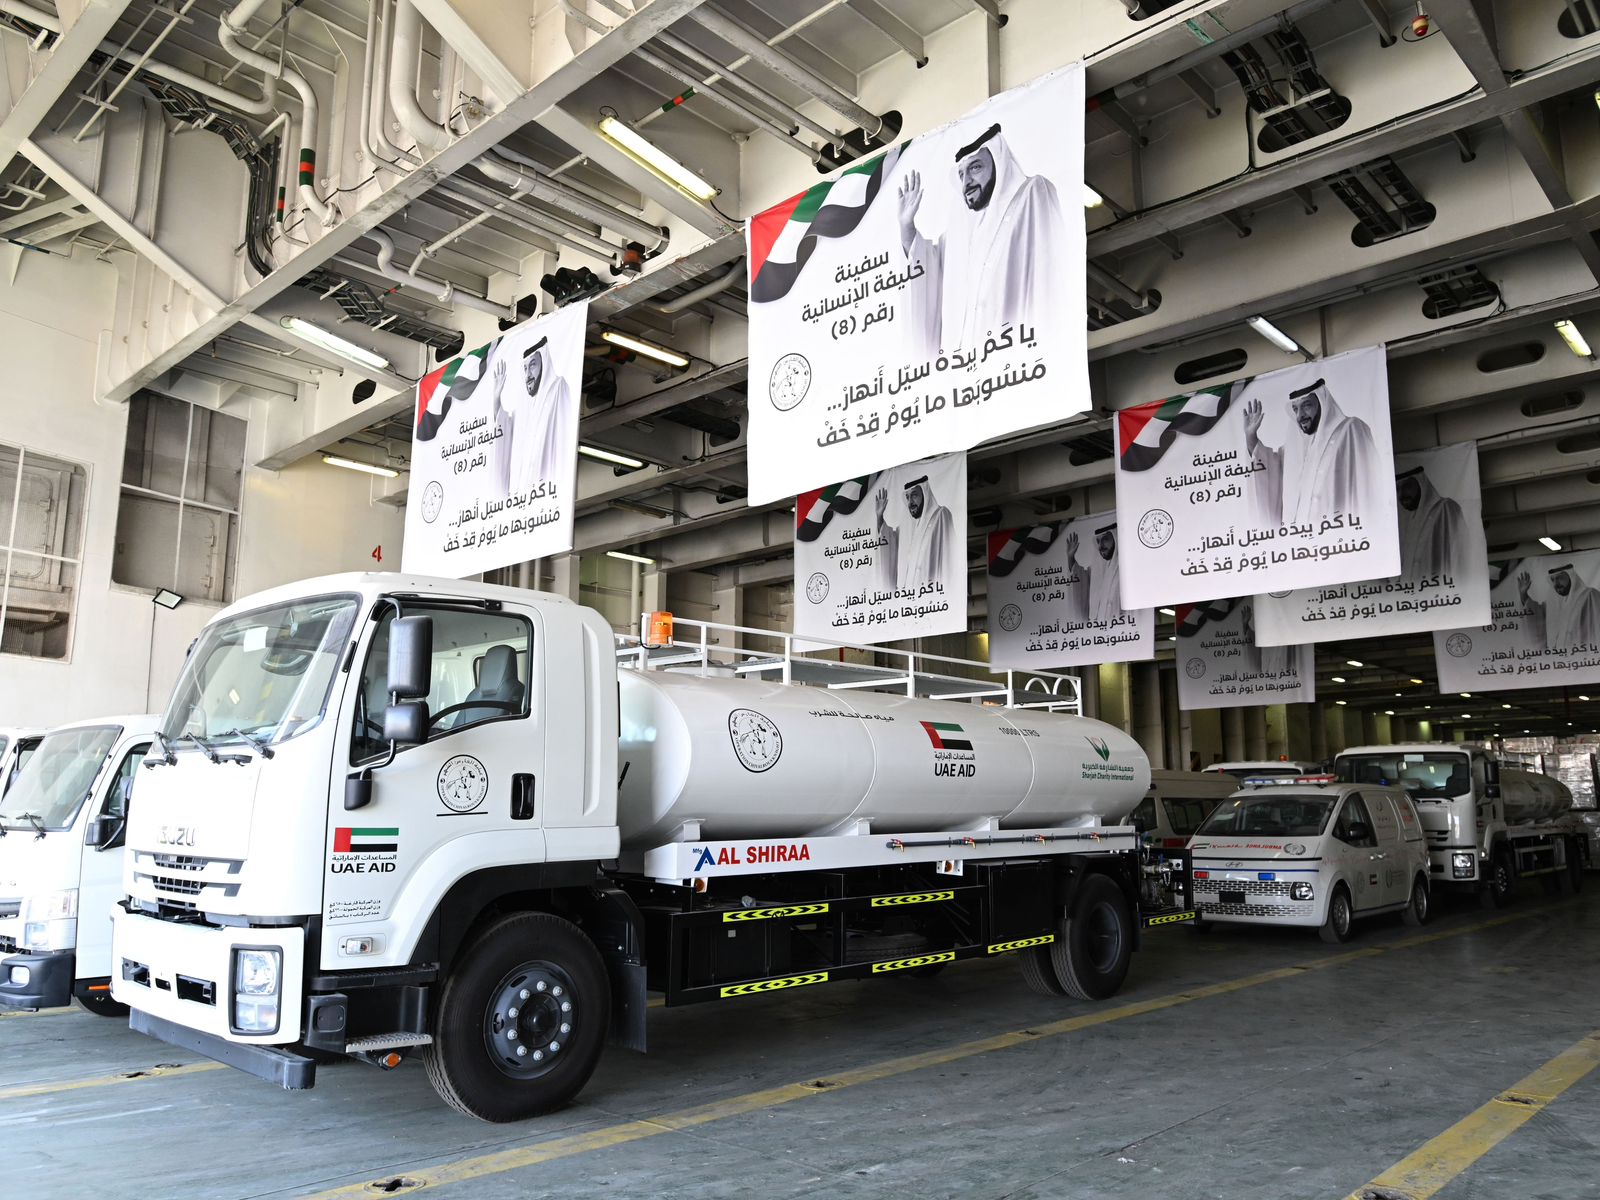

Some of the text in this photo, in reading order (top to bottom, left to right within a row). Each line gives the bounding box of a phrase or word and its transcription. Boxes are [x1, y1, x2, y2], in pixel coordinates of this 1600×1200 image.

[835, 251, 889, 283] سفينة
[802, 260, 925, 324] خليفة الإنسانية
[831, 302, 894, 340] رقم (8)
[1020, 323, 1037, 348] يا
[925, 395, 946, 414] ما
[458, 416, 487, 435] سفينة
[477, 425, 504, 446] خليفة
[469, 452, 487, 473] رقم
[1191, 450, 1237, 467] سفينة
[1224, 459, 1267, 478] خليفة
[1215, 484, 1242, 502] رقم
[1348, 512, 1363, 530] يا
[498, 523, 509, 537] ما
[841, 528, 870, 540] سفينة
[862, 536, 889, 551] خليفة
[371, 545, 382, 562] 4
[855, 554, 873, 569] رقم
[1271, 550, 1288, 563] ما
[888, 608, 899, 619] ما
[808, 709, 839, 718] للشرب
[873, 714, 895, 722] مياه
[934, 762, 976, 777] UAE AID
[717, 844, 810, 865] AL SHIRAA
[331, 862, 396, 873] UAE AID
